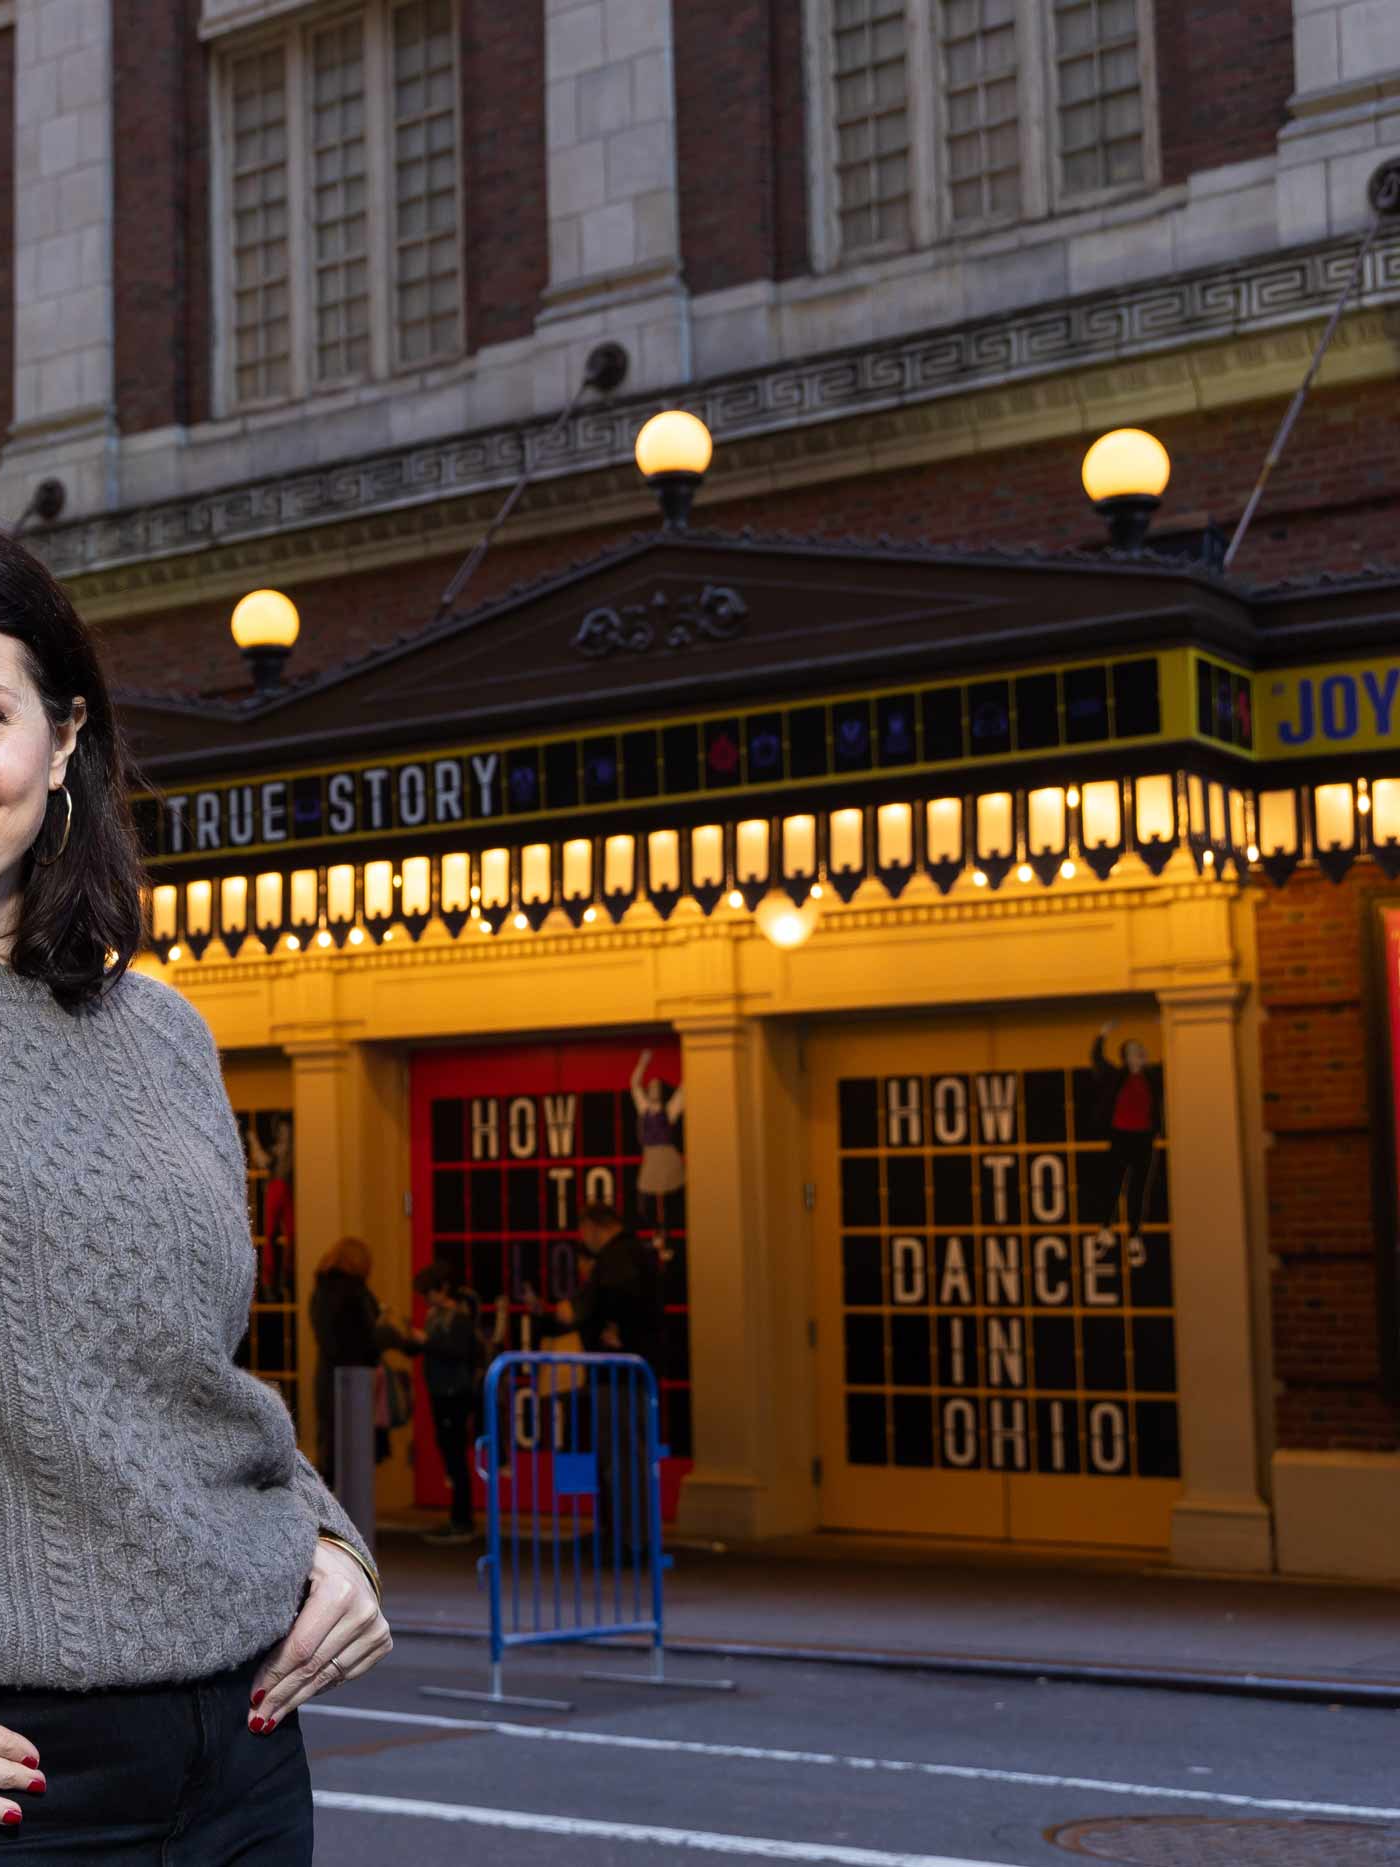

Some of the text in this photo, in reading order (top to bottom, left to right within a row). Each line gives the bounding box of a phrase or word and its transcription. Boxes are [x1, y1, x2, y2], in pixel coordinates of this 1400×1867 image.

[1277, 668, 1400, 745] JOY
[167, 754, 497, 852] TRUE STORY
[472, 1093, 576, 1160] HOW
[887, 1073, 1018, 1145] HOW
[983, 1154, 1067, 1223] TO
[891, 1235, 1119, 1305] DANCE
[951, 1316, 1025, 1388] IN
[943, 1397, 1126, 1473] OHIO
